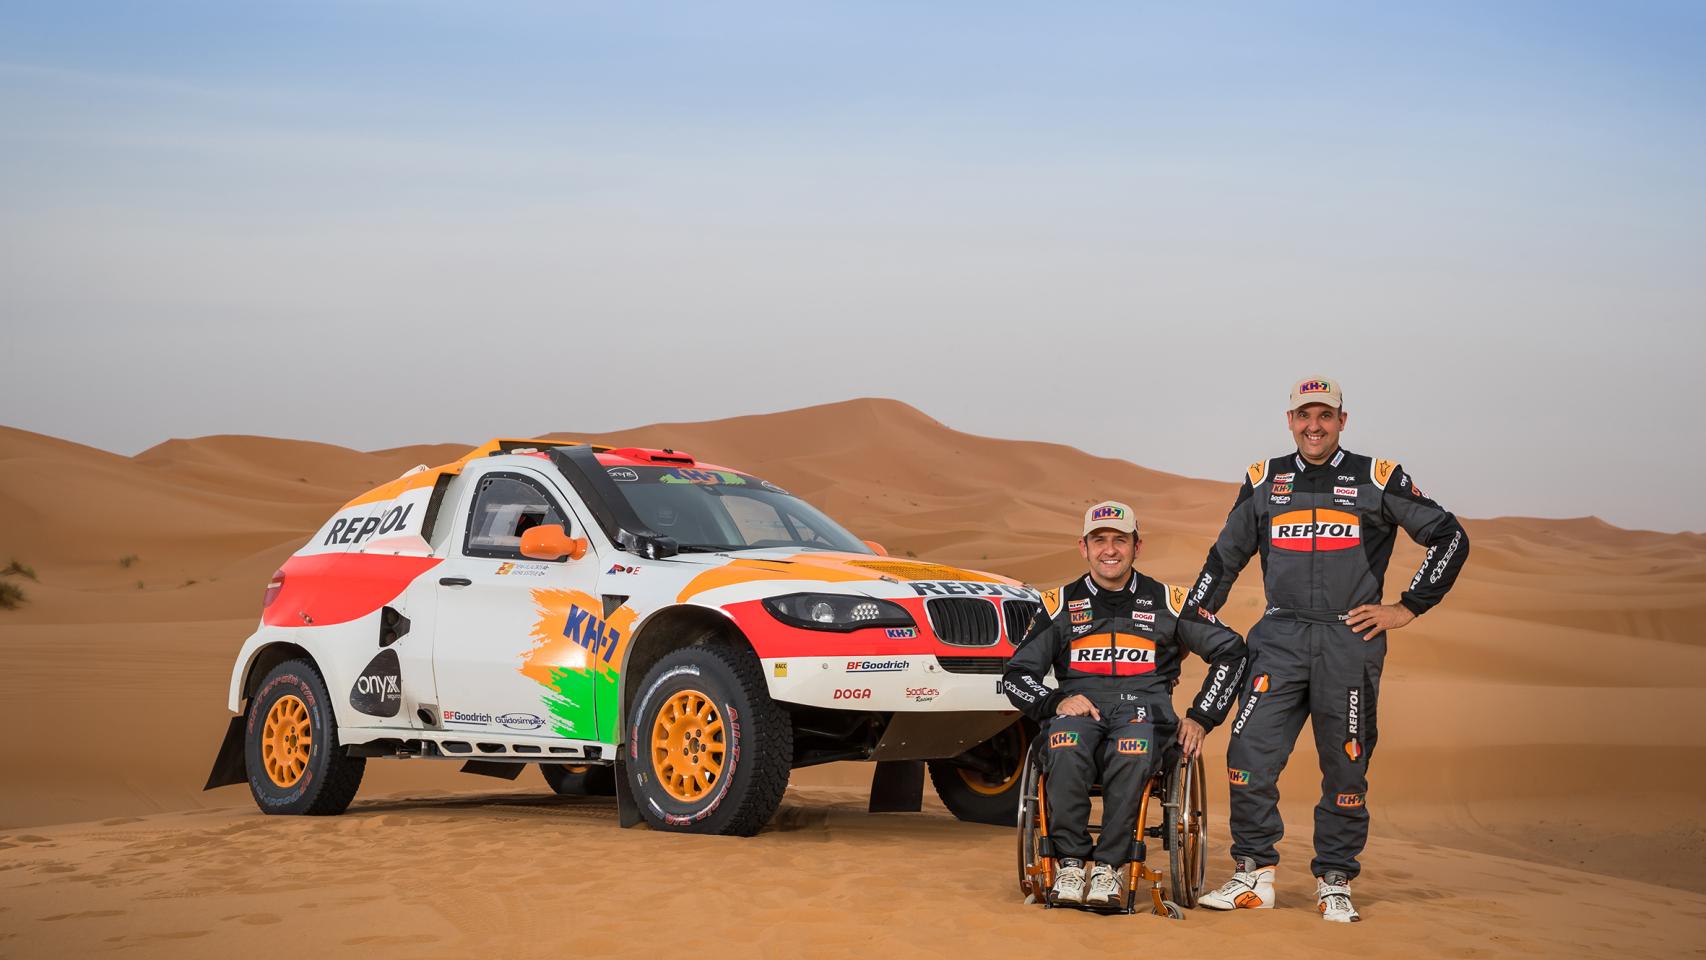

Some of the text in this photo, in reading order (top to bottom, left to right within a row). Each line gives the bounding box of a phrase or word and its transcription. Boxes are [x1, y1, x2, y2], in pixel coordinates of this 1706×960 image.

[1302, 383, 1328, 391] KH-7
[1094, 508, 1121, 518] KH-7
[324, 503, 415, 546] REPOL
[1279, 524, 1354, 538] REPSOL
[1072, 611, 1091, 622] KH-7
[563, 603, 620, 663] KH-7
[887, 629, 914, 638] KH-7
[1078, 648, 1149, 662] REPSOL
[846, 661, 910, 671] BFGoodrich
[1200, 663, 1230, 712] REPSOL
[834, 689, 871, 699] DOGA
[444, 711, 492, 723] BFGoodrich
[1233, 694, 1258, 735] REPSOL
[1349, 690, 1359, 734] REPSOL
[1052, 733, 1078, 746] KH-7
[1120, 741, 1147, 751] KH-7
